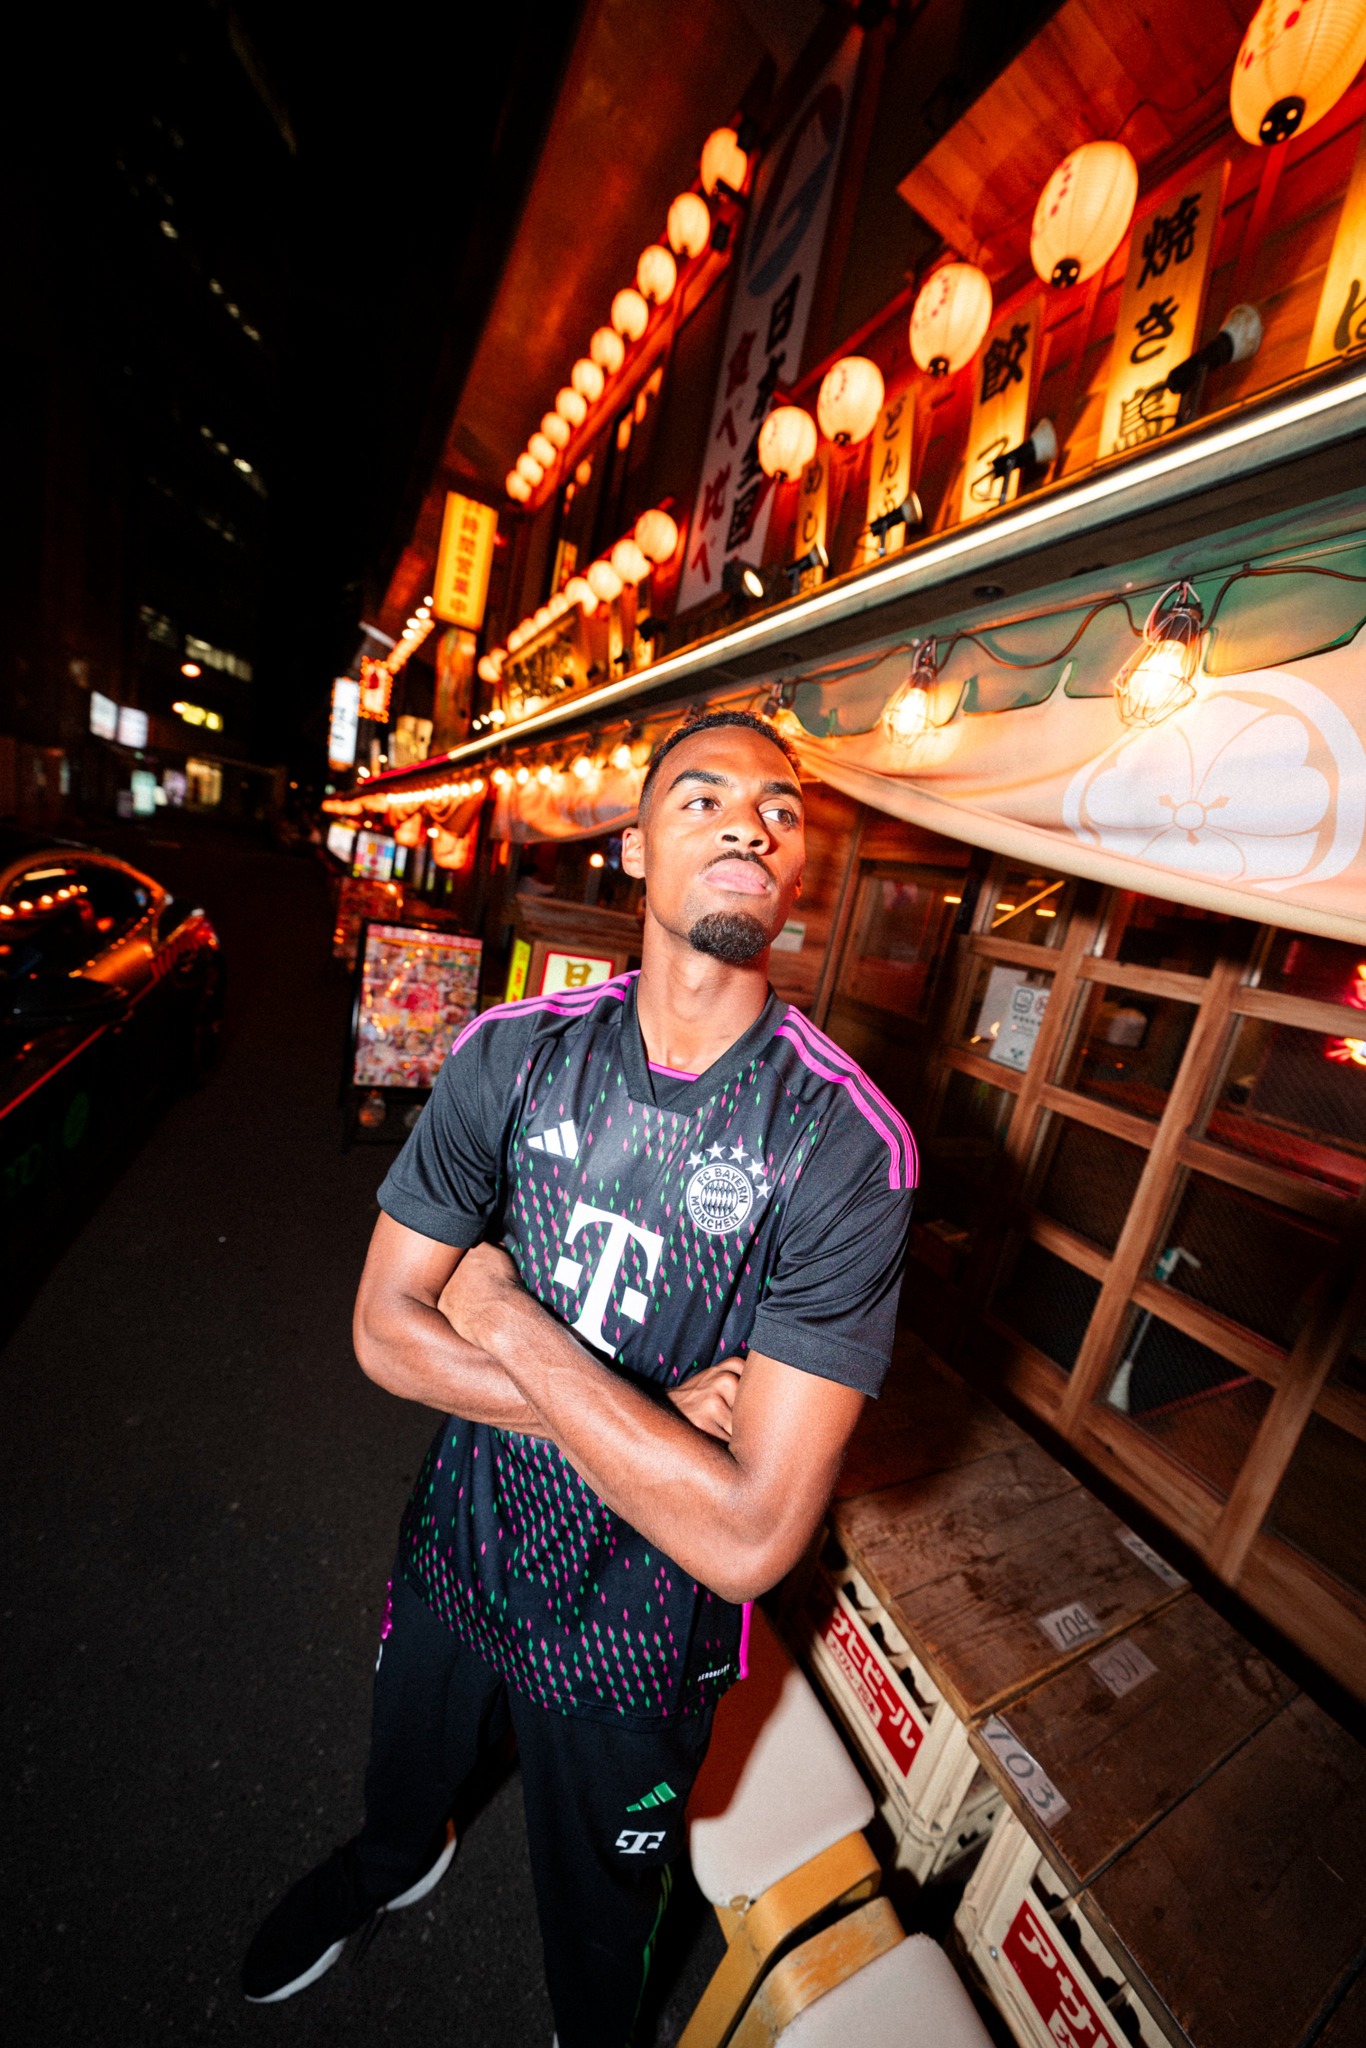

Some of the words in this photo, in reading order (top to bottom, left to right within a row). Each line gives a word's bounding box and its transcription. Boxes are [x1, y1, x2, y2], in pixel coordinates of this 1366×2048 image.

[1113, 191, 1202, 453] 焼き鳥
[696, 1171, 712, 1187] FC
[714, 1167, 749, 1204] BAYERN
[697, 1663, 731, 1683] AEROREADY
[831, 1605, 917, 1750] サヒビール
[986, 1731, 1056, 1810] 103
[1018, 1912, 1110, 2048] アサ
